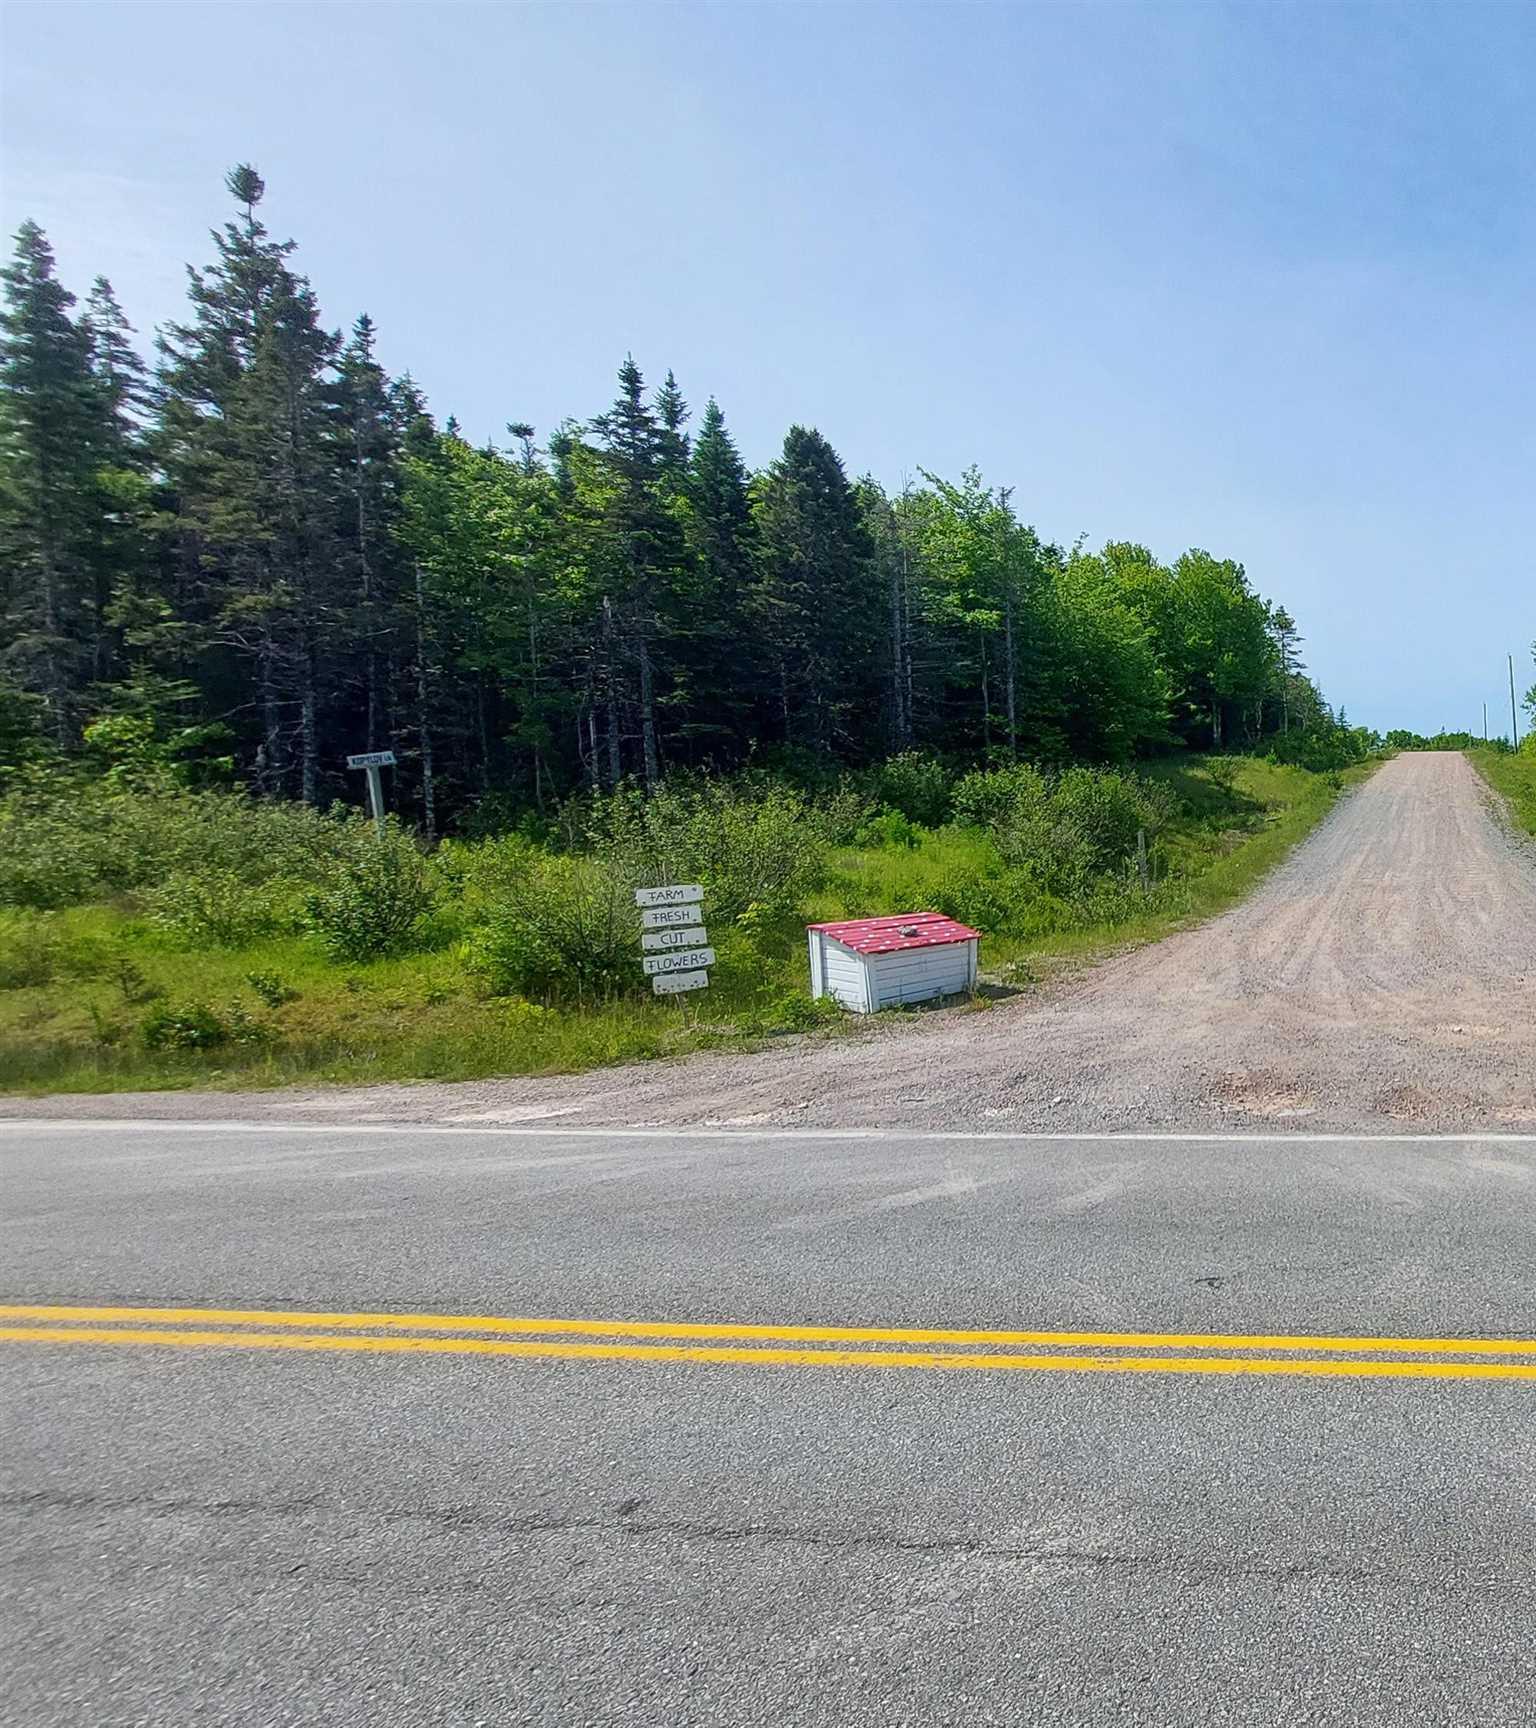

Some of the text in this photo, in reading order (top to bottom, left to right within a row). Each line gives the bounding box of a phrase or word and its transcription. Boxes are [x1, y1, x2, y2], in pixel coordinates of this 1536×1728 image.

[647, 889, 685, 902] FARM
[652, 910, 690, 923] FRESH
[660, 931, 686, 945] CUT
[646, 951, 708, 971] FLOWERS
